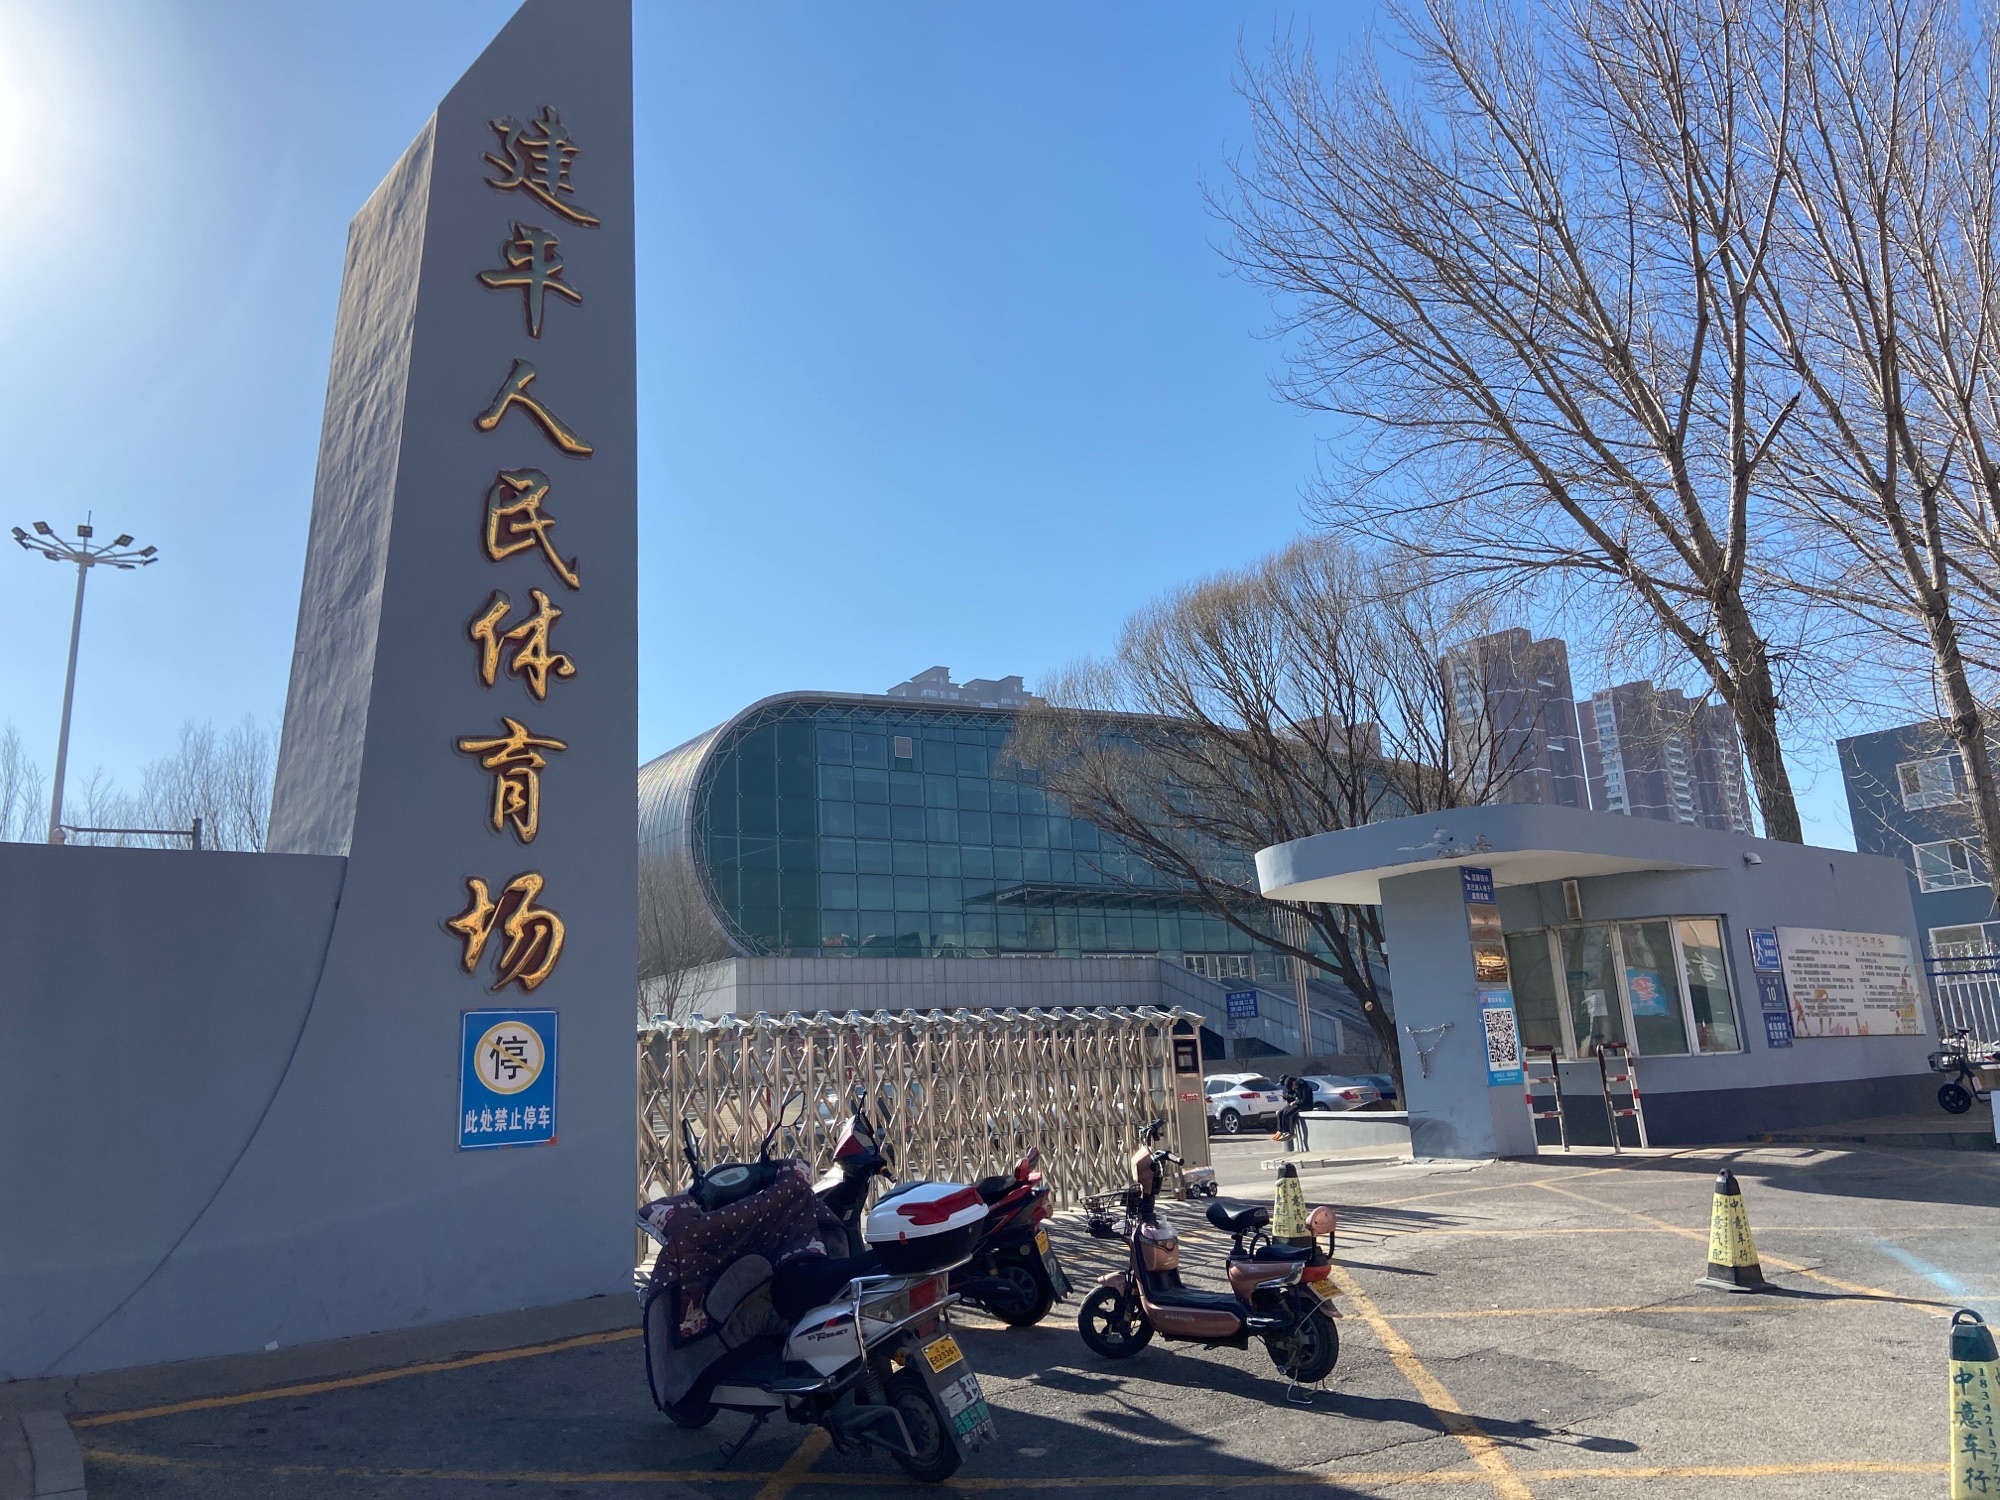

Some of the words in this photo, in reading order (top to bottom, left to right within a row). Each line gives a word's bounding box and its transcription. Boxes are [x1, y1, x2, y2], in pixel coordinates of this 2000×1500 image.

[448, 105, 600, 991] 建平人民体育场
[1766, 986, 1777, 1001] 10
[489, 1035, 528, 1080] 停
[464, 1105, 551, 1133] 此处禁止停车
[1953, 1367, 1991, 1494] 中意车行
[1978, 1367, 2000, 1493] 1834213777
